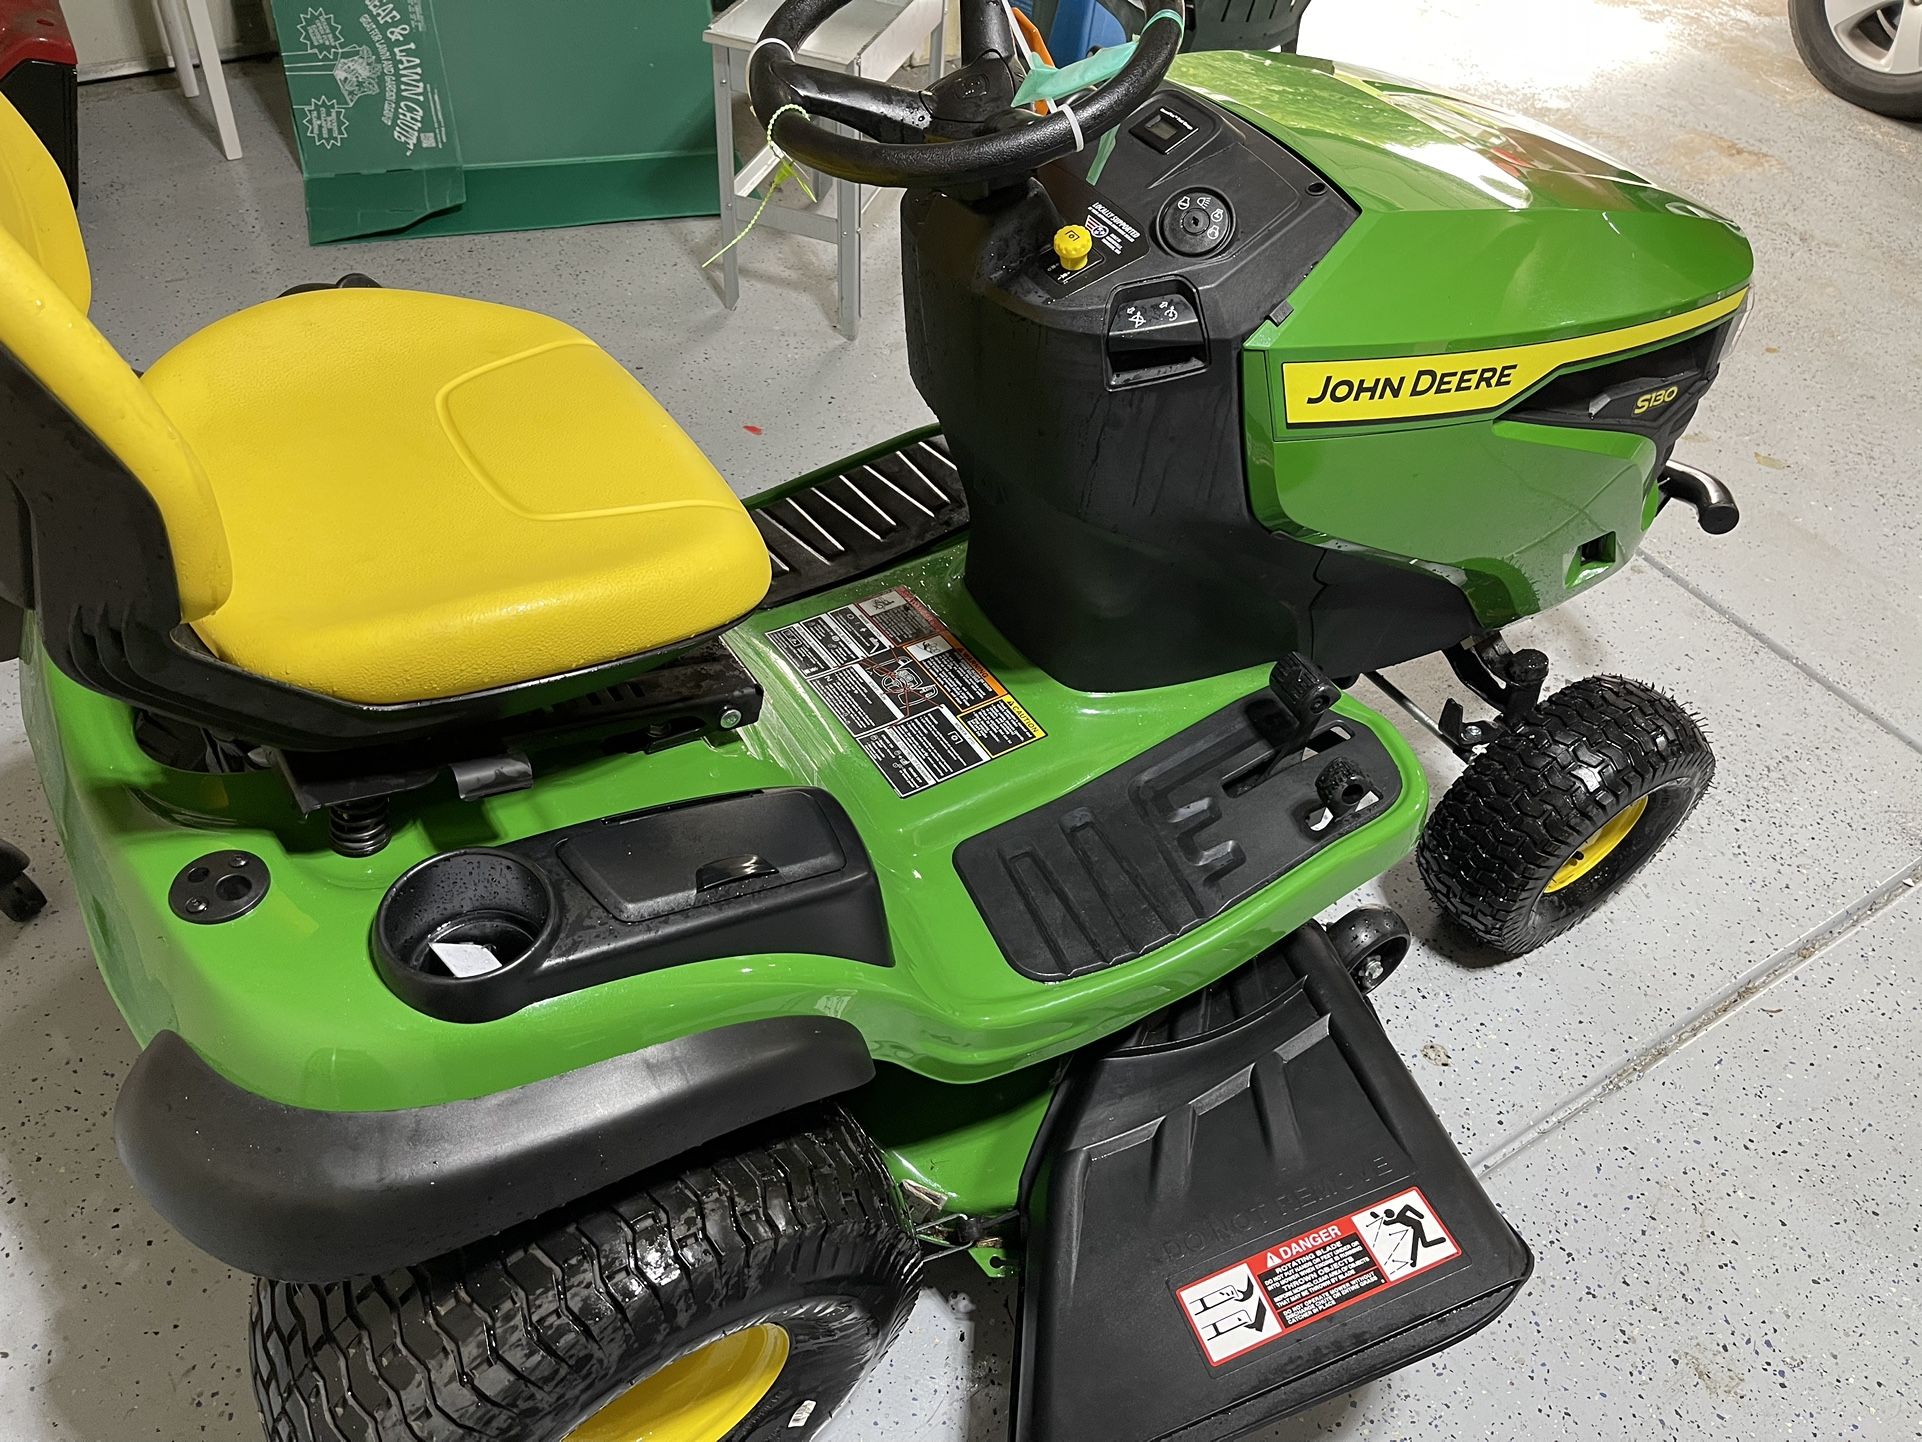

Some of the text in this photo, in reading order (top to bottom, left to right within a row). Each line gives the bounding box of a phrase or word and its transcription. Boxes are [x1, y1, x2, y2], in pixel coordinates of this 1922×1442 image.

[365, 0, 401, 24] EAF
[369, 29, 383, 42] FOR
[387, 25, 410, 41] &
[376, 41, 391, 61] LAWN
[382, 60, 395, 75] AND
[393, 42, 424, 102] LAWN
[393, 101, 424, 150] CHUTE
[1092, 202, 1114, 220] LOCALLY
[1111, 214, 1141, 239] SUPPORTED
[1307, 364, 1518, 405] JOHN DEERE
[1634, 386, 1679, 415] S130
[961, 651, 989, 678] WARNING
[1010, 705, 1039, 732] CAUTION
[1279, 1225, 1340, 1258] DANGER
[1275, 1240, 1342, 1273] ROTATING BLADE
[1281, 1256, 1354, 1290] THROWN OBJECTS
